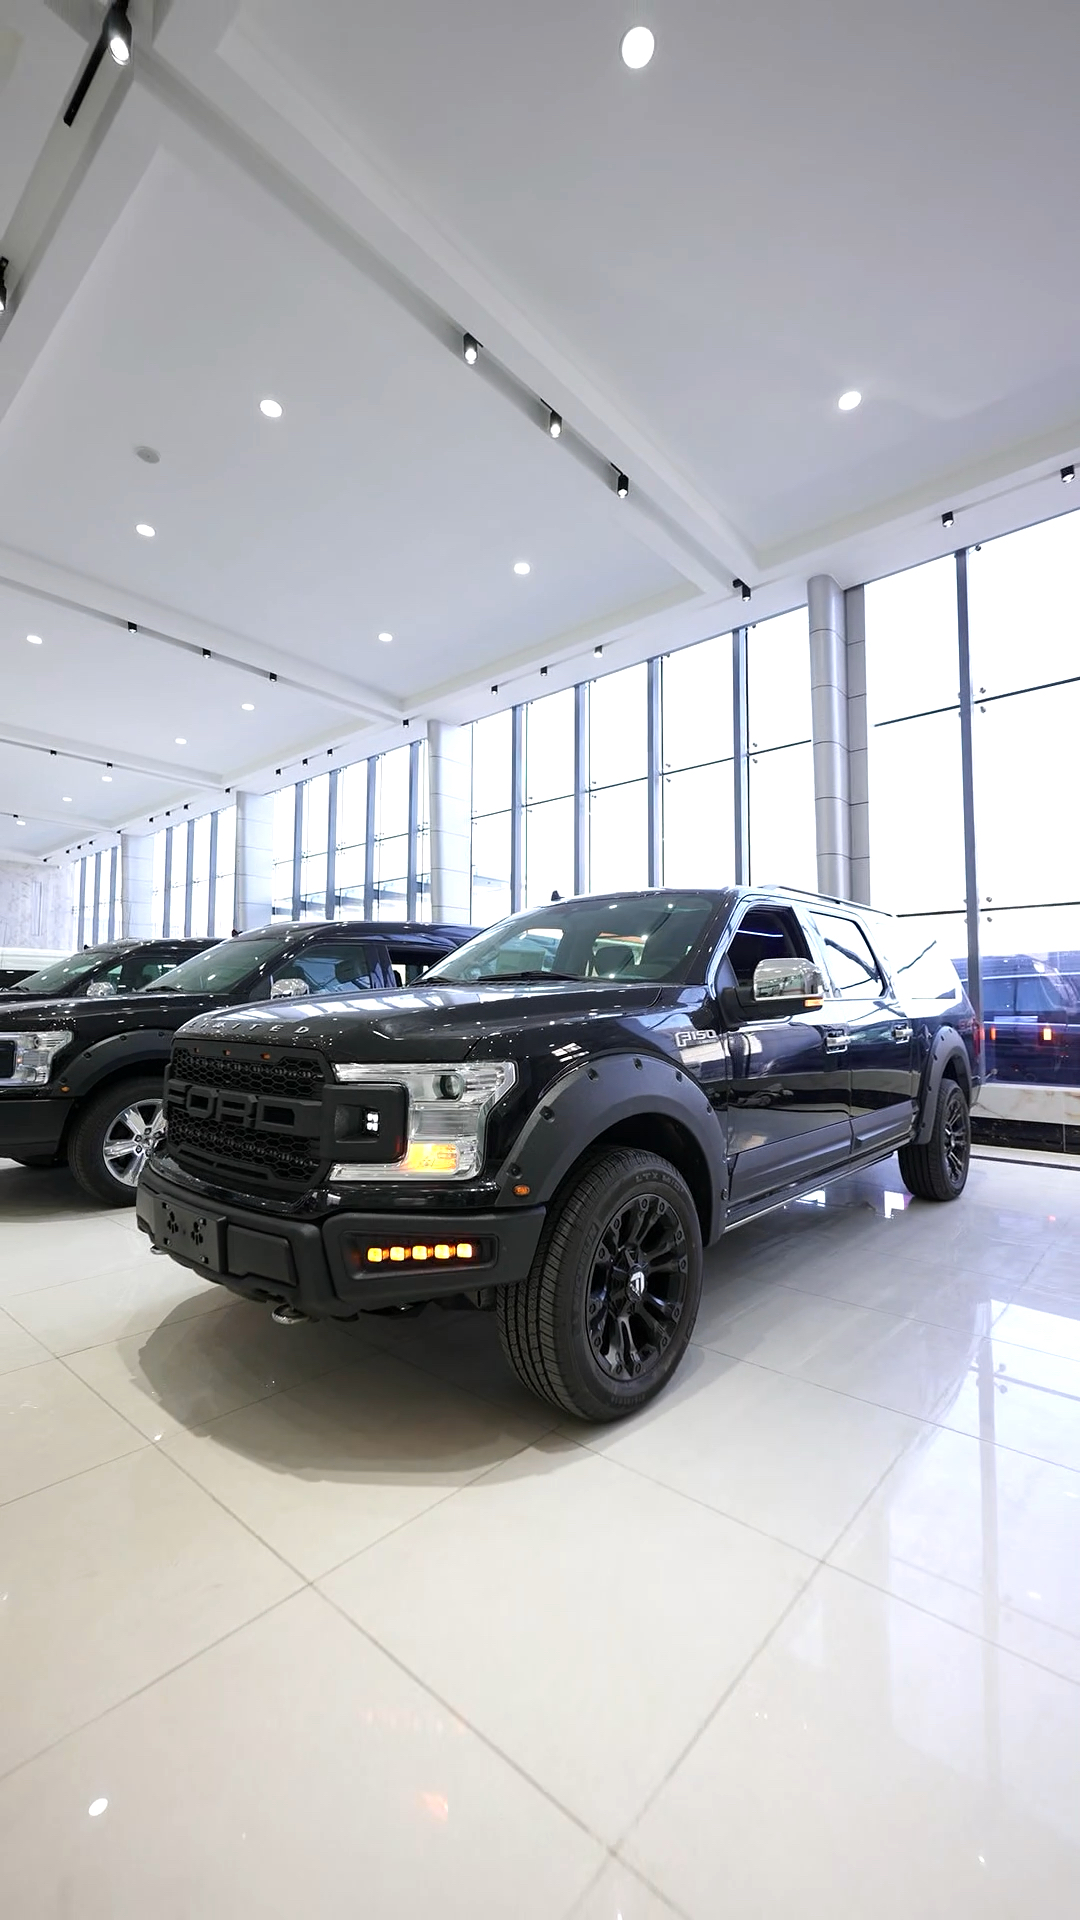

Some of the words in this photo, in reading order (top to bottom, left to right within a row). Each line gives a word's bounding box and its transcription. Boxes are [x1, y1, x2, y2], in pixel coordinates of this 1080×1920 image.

[188, 1021, 310, 1035] LIMITED
[675, 1029, 718, 1048] F150
[164, 1079, 305, 1135] FORD
